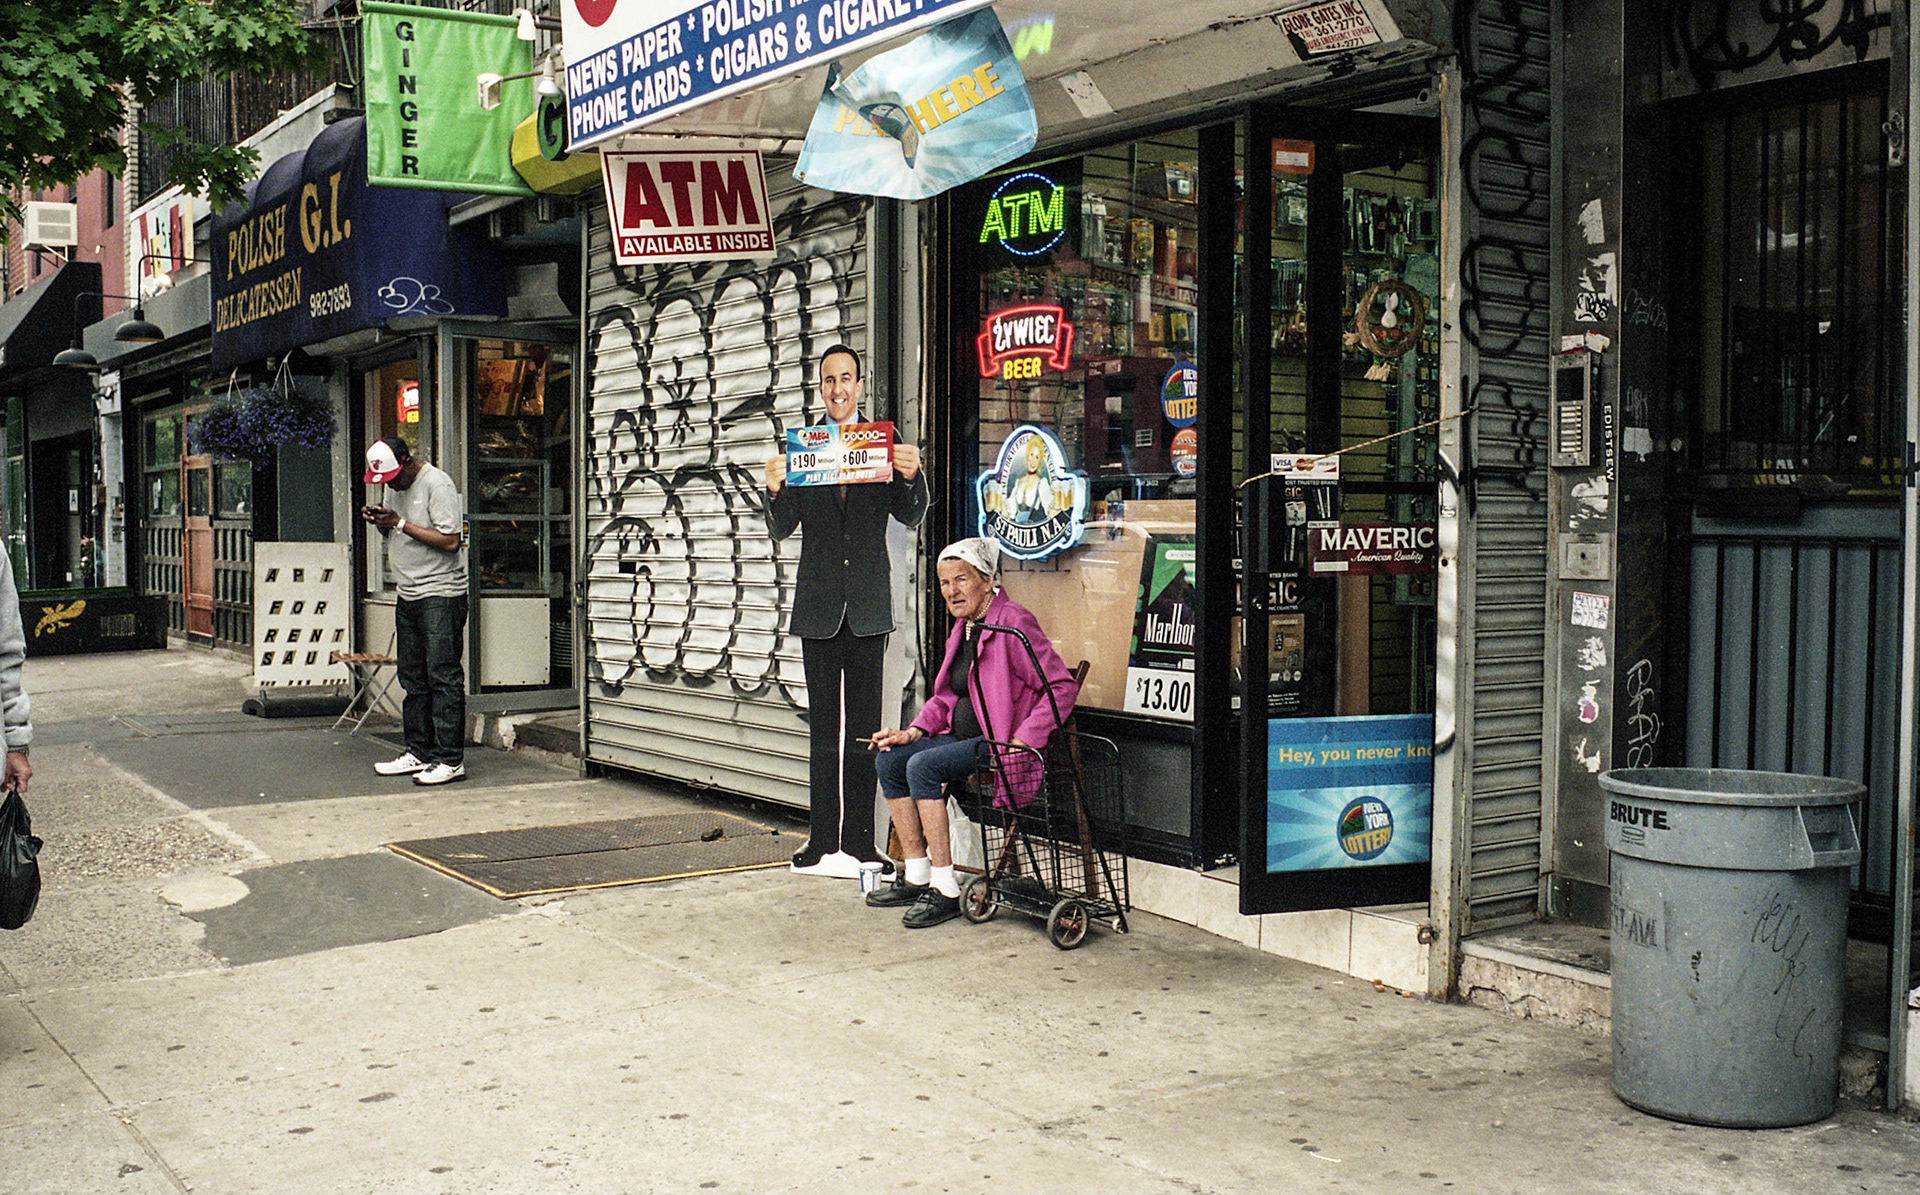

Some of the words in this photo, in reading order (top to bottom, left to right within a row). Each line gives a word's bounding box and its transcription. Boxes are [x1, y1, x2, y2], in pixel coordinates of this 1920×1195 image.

[1282, 13, 1314, 33] GLOBE
[1311, 5, 1342, 25] GATES
[1339, 0, 1363, 17] INC.
[1314, 16, 1364, 36] 361-2770
[1352, 25, 1374, 36] REPAIRS
[569, 49, 618, 100] NEWS
[621, 20, 683, 77] PAPER
[573, 86, 628, 138] PHONE
[630, 60, 692, 115] CARDS
[710, 22, 789, 84] CIGARS
[795, 13, 812, 54] &
[395, 21, 419, 175] GINGER
[905, 61, 1005, 135] HERE
[623, 161, 760, 229] ATM
[227, 204, 287, 281] POLISH
[300, 171, 351, 254] G.I.
[979, 186, 1064, 243] ATM
[623, 235, 712, 255] AVAILABLE
[716, 233, 769, 250] INSIDE
[216, 267, 302, 333] DELICATESSEN
[310, 283, 351, 318] 982-7893
[1003, 356, 1042, 380] BEER
[809, 431, 829, 441] MEGA
[843, 430, 879, 441] POWER
[793, 453, 816, 468] $190
[842, 450, 868, 465] $600
[1007, 525, 1039, 547] PAULI
[1041, 518, 1066, 540] N.A.
[1320, 527, 1435, 551] MAVERIC
[1350, 551, 1392, 562] American
[1393, 549, 1424, 564] Quality
[265, 568, 334, 582] APT
[269, 600, 327, 615] FOR
[264, 628, 345, 643] RENT
[1137, 677, 1191, 713] $13.00
[1279, 748, 1315, 766] Hey,
[1320, 750, 1350, 765] you
[1356, 748, 1402, 760] never
[1363, 802, 1384, 814] NEW
[1365, 813, 1390, 829] YORK
[1342, 826, 1392, 855] LOTTERY
